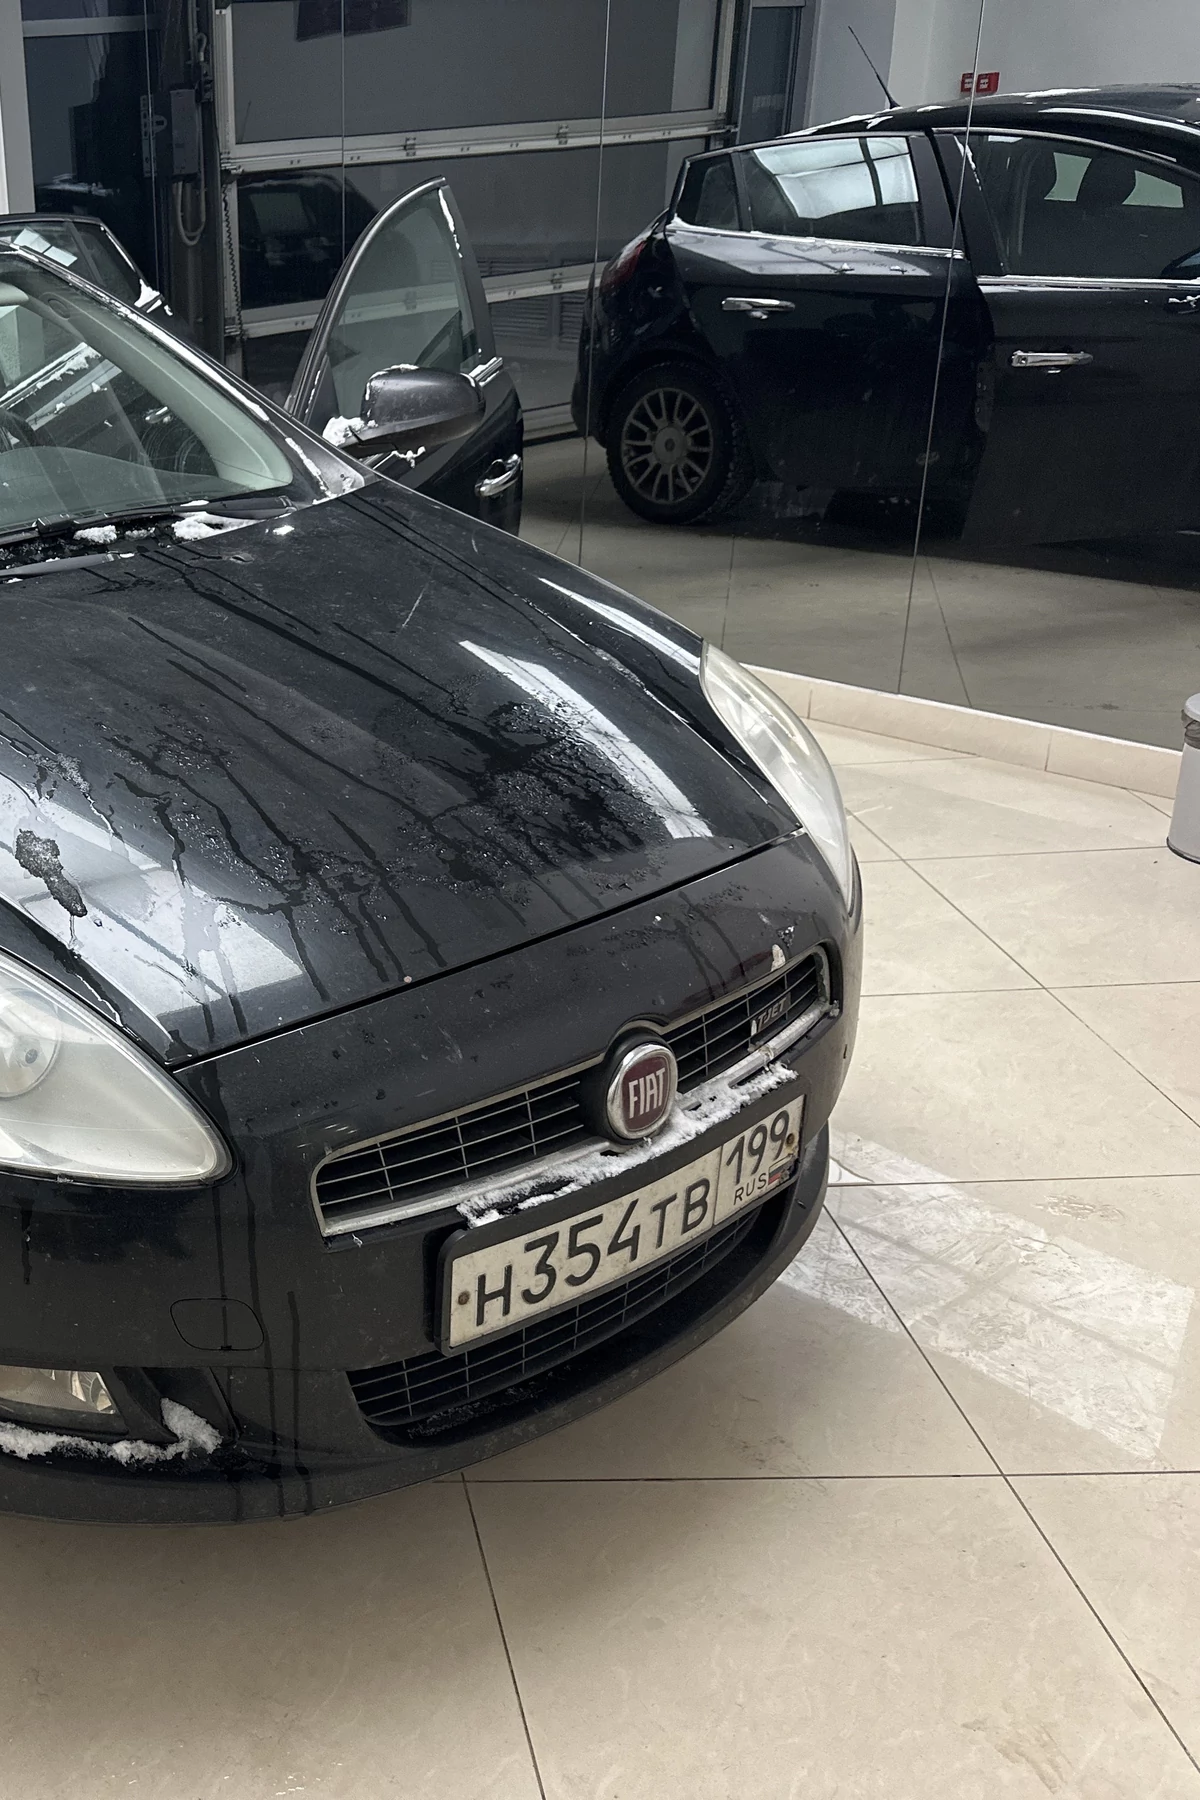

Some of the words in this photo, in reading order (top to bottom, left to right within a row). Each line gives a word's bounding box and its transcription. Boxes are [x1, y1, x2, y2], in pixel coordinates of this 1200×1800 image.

[628, 1067, 666, 1119] FIAT
[725, 1109, 790, 1186] 199
[733, 1172, 767, 1206] RUS
